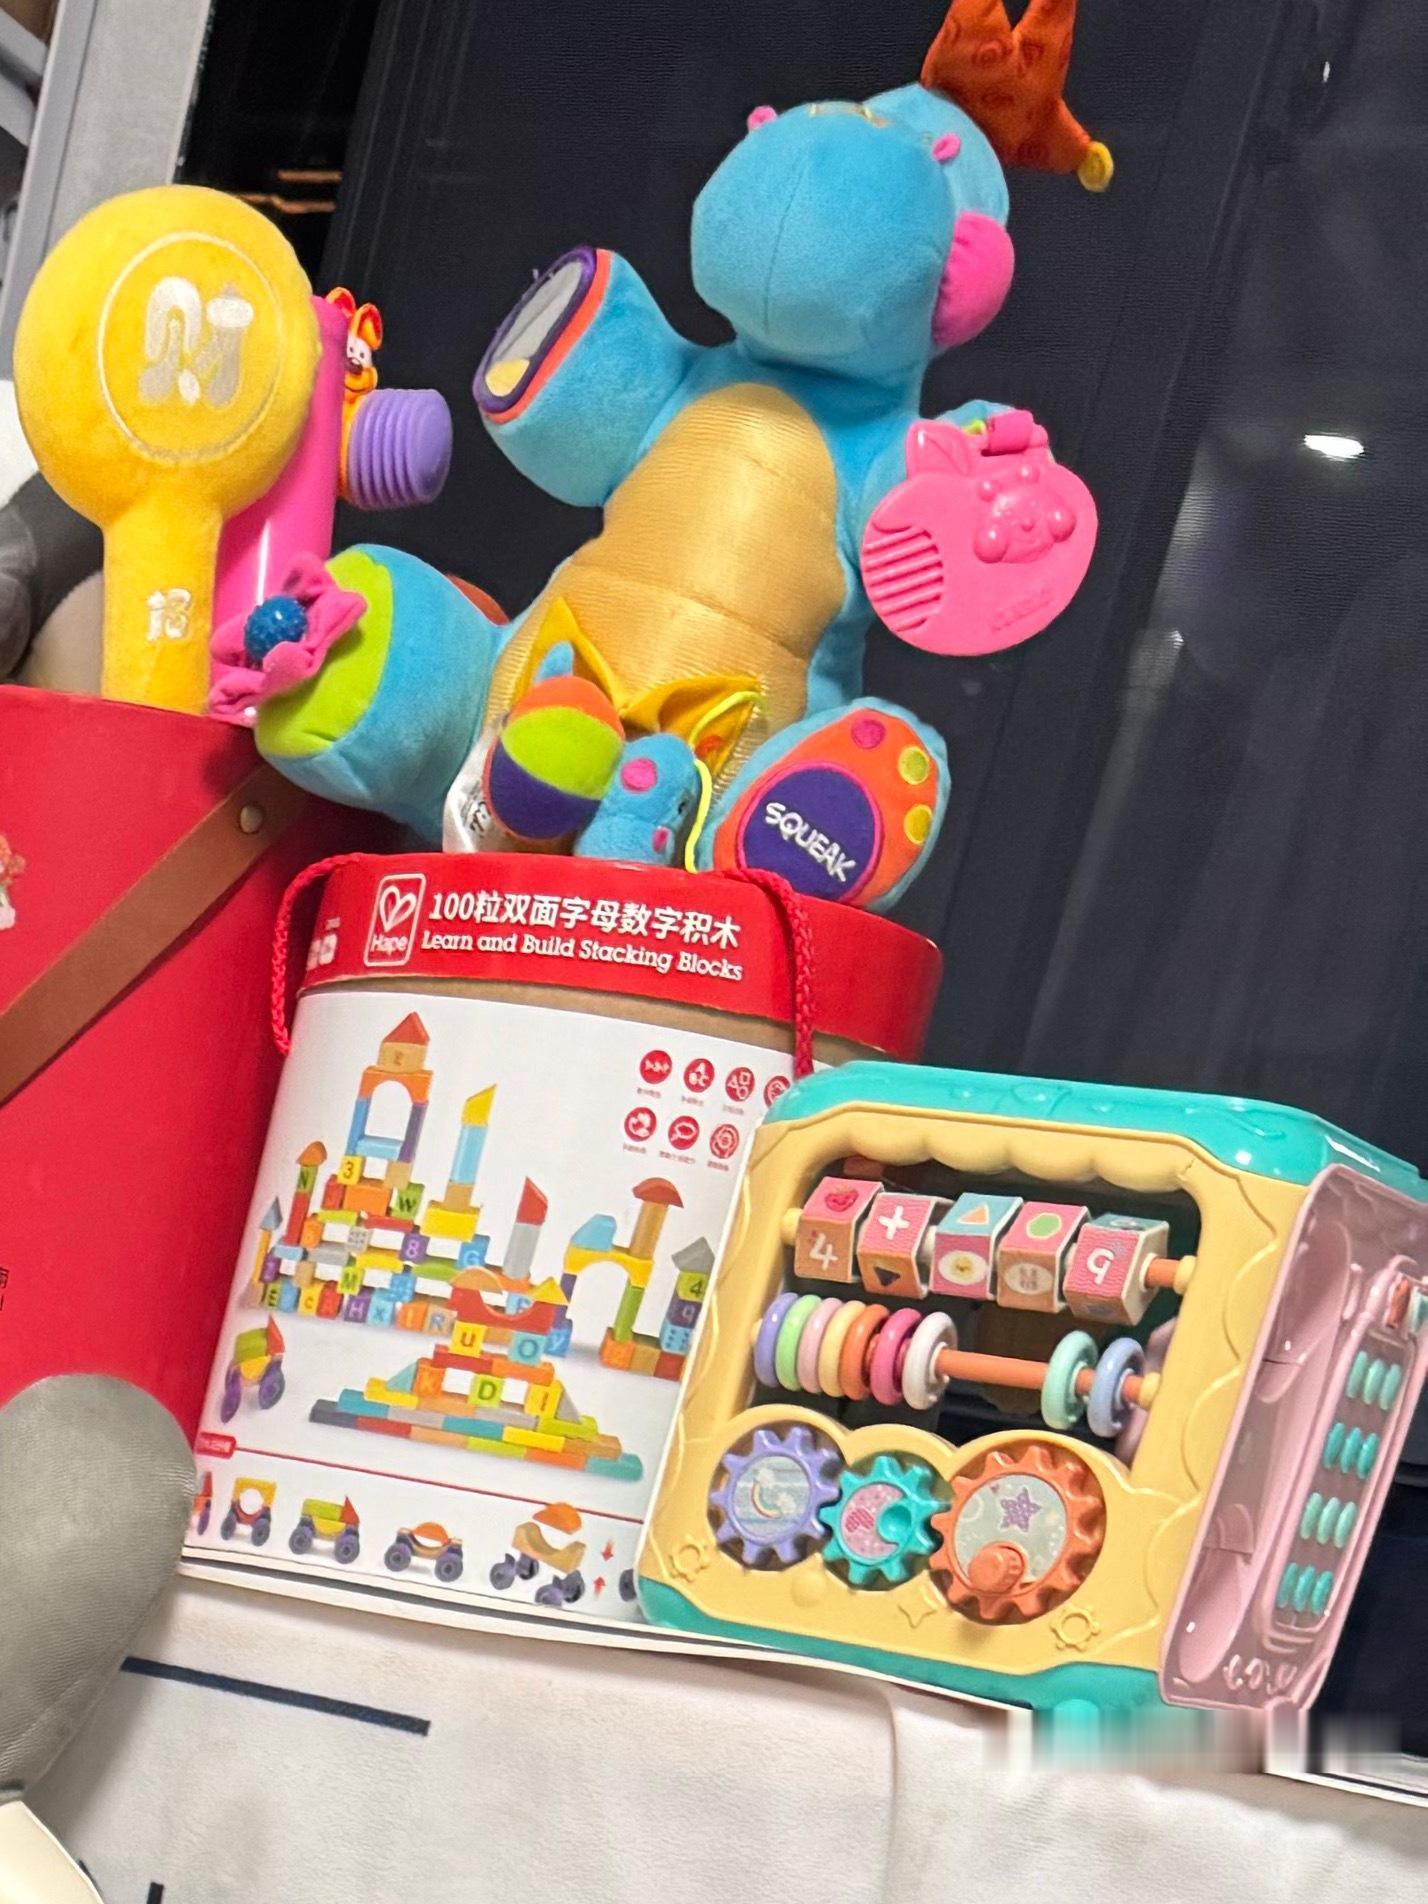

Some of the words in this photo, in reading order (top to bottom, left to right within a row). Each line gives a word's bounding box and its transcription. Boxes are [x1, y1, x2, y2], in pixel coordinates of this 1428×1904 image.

[765, 802, 856, 882] SQUEAK
[370, 932, 409, 954] Hape
[429, 890, 741, 950] 100粒双面字母数字积木
[421, 929, 474, 951] Learn
[477, 934, 517, 954] and
[523, 933, 575, 958] Build
[579, 940, 673, 974] Stacking
[677, 953, 744, 981] Blocks
[808, 1232, 839, 1271] 4
